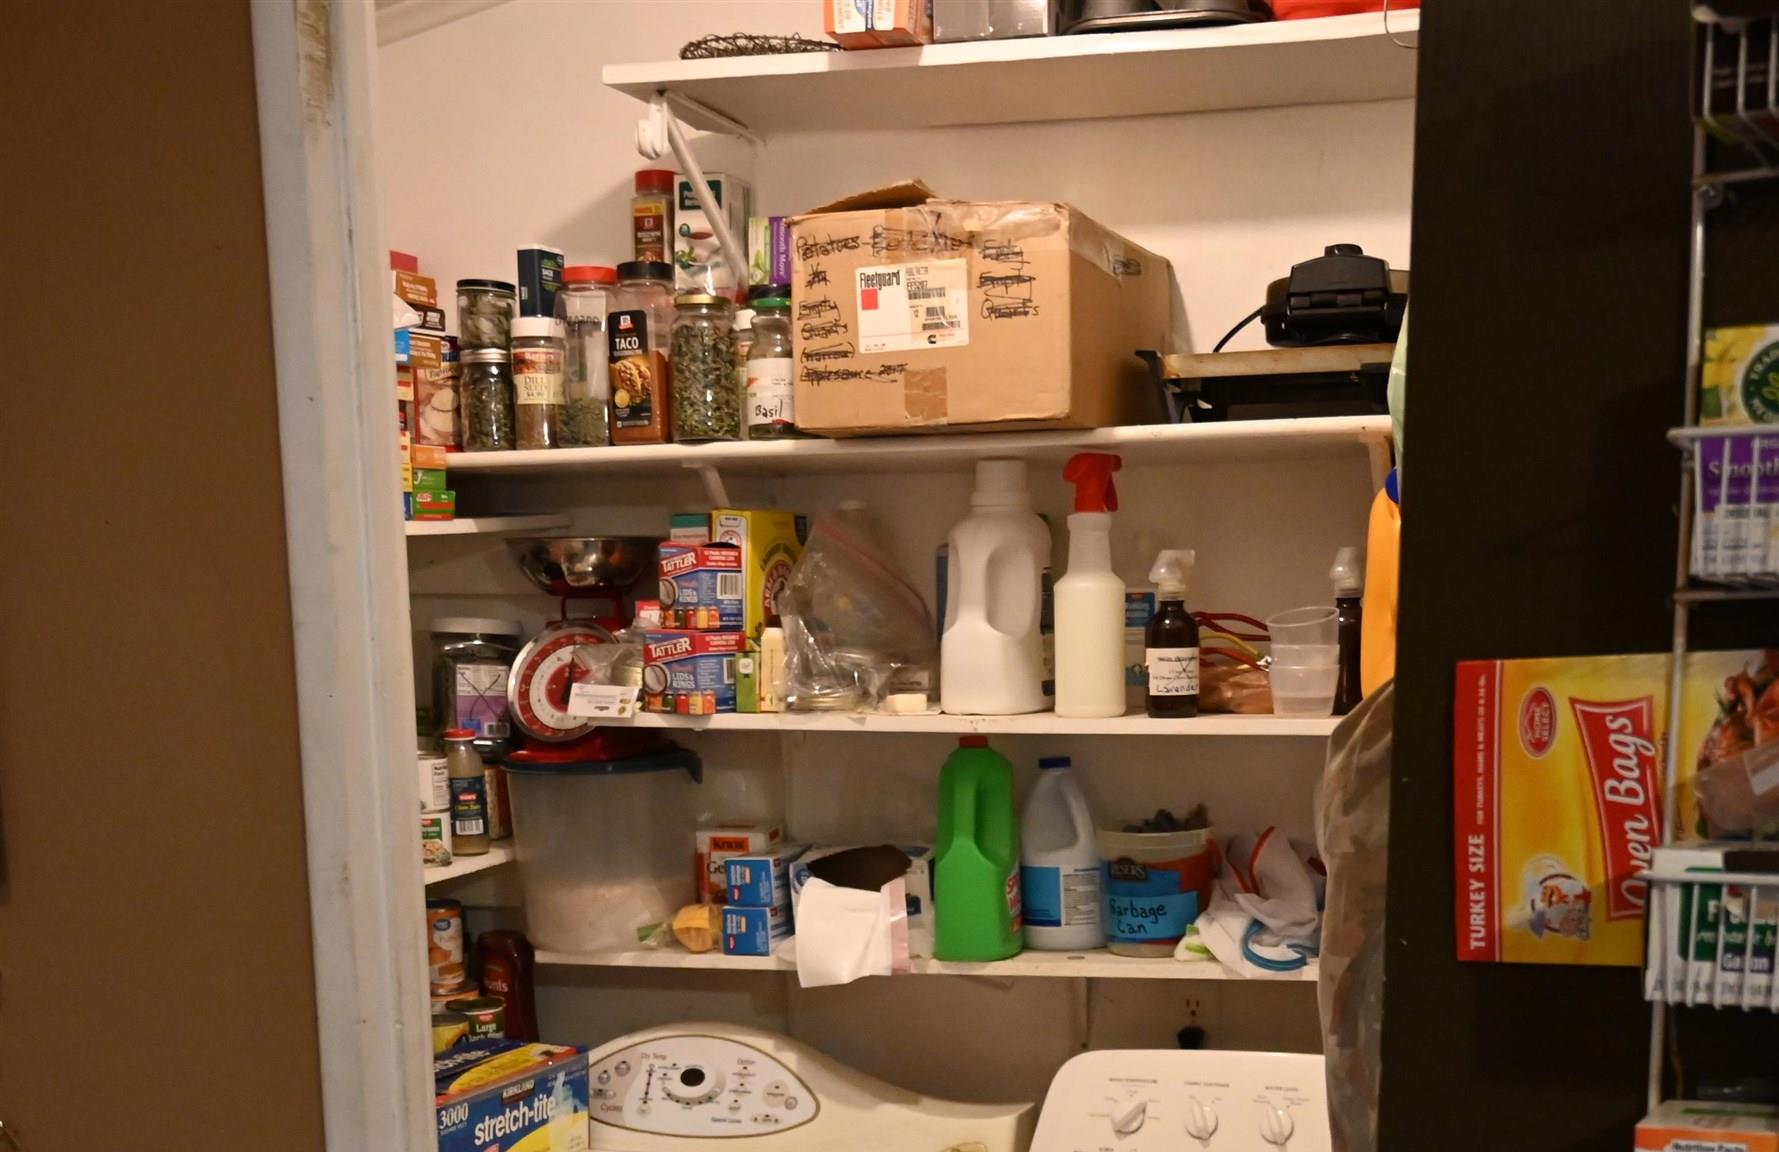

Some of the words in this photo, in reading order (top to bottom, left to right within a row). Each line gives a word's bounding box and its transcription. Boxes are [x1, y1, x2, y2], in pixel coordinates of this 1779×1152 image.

[859, 269, 901, 291] Fleetguard
[615, 337, 639, 350] TACO
[754, 399, 783, 419] Basil
[661, 552, 697, 574] TATTLER
[648, 637, 693, 659] TATTLER
[1603, 715, 1656, 805] Bags
[1468, 833, 1485, 873] SIZE
[1469, 880, 1487, 950] TURKEY
[1117, 919, 1148, 935] Can
[1722, 952, 1770, 971] Gaon
[439, 1101, 469, 1130] 3000
[474, 1093, 557, 1146] stretch-tite
[1672, 1142, 1715, 1152] Nutrition
